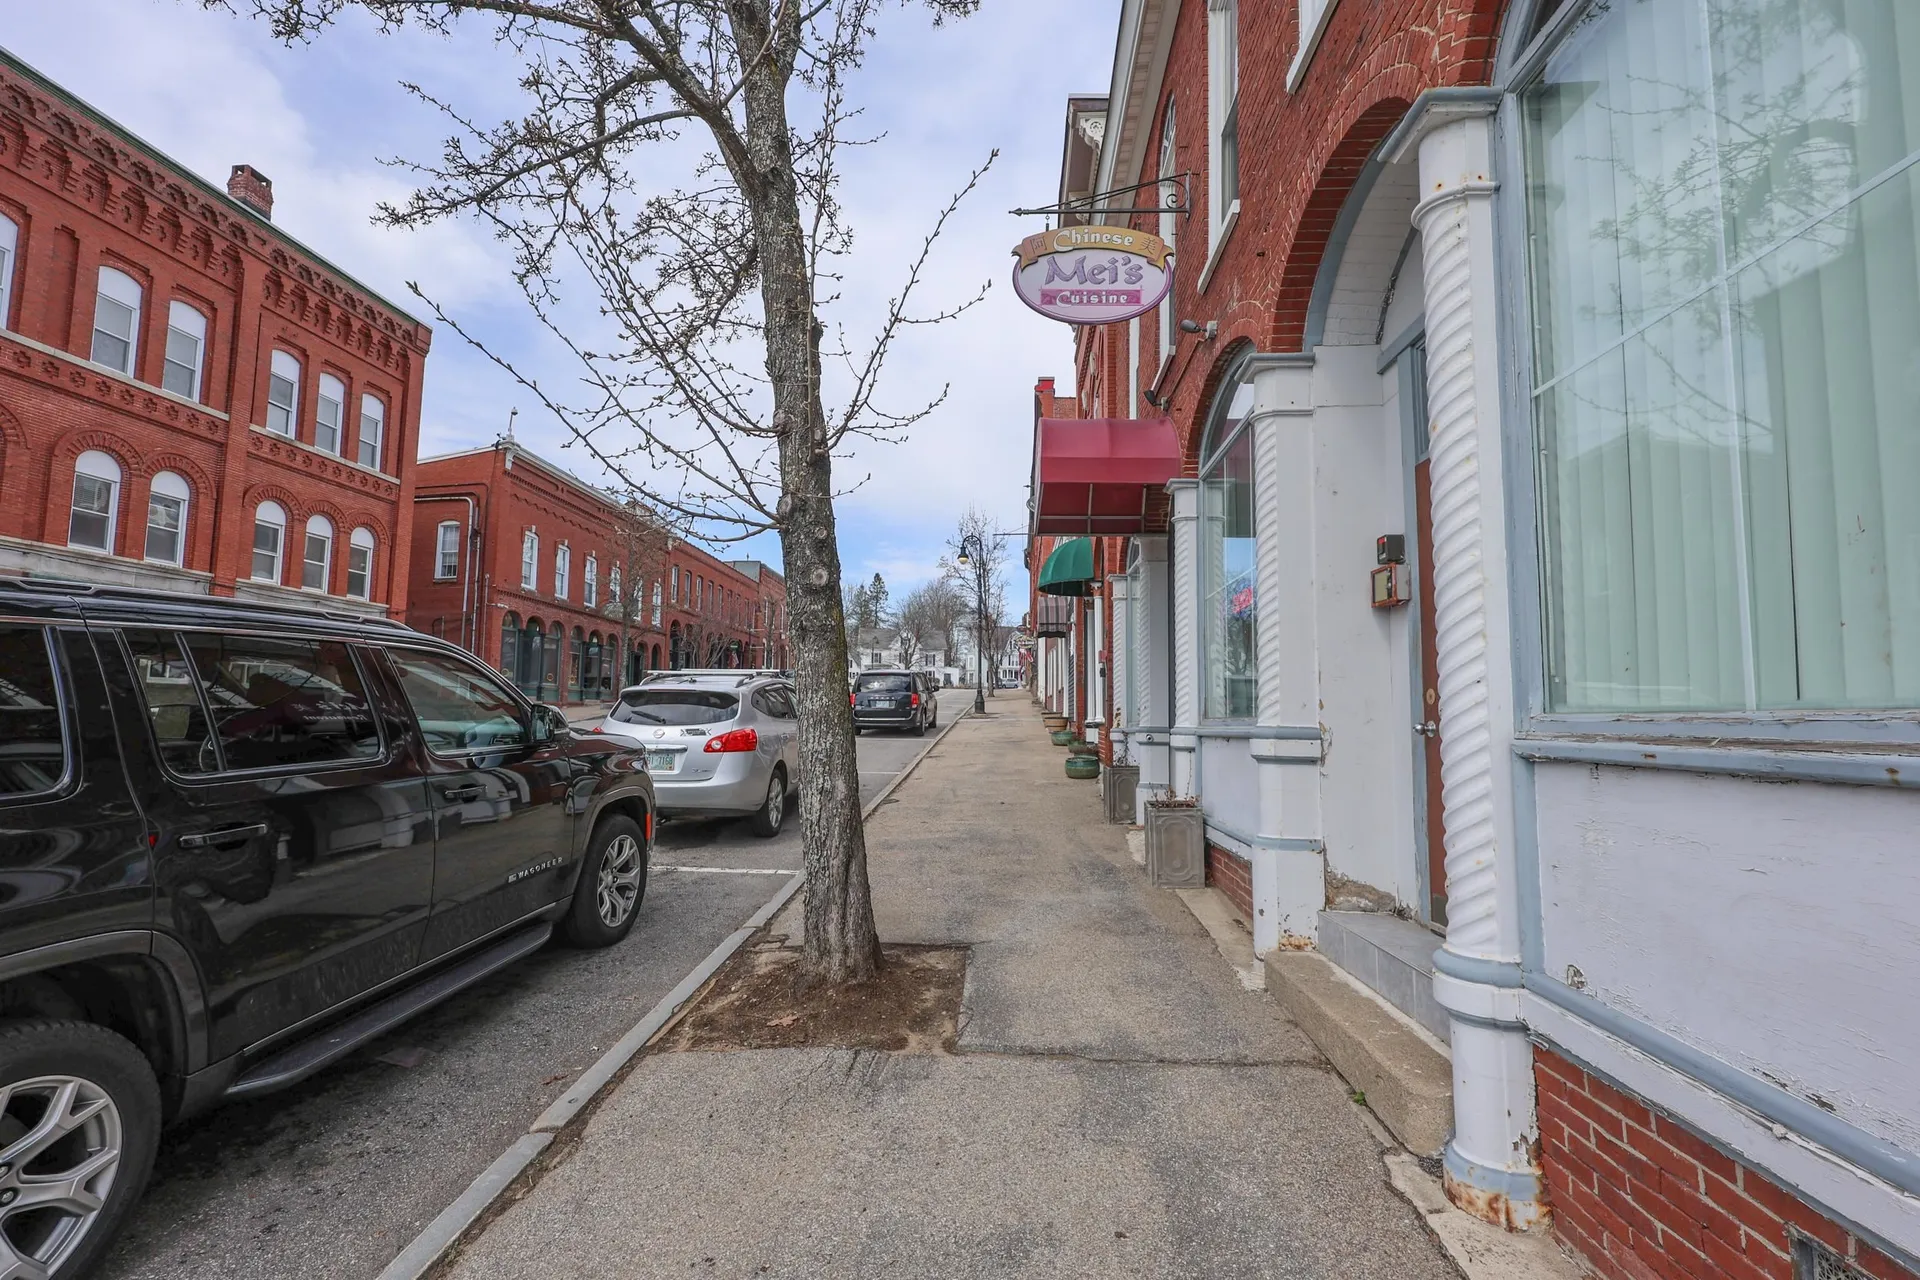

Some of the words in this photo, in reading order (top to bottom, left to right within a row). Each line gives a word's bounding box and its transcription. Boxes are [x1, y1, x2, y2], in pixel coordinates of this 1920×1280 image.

[1053, 229, 1134, 251] Chinese
[1044, 255, 1144, 285] Mei's
[1056, 291, 1128, 308] Cuisine
[518, 857, 563, 879] WAGONEER
